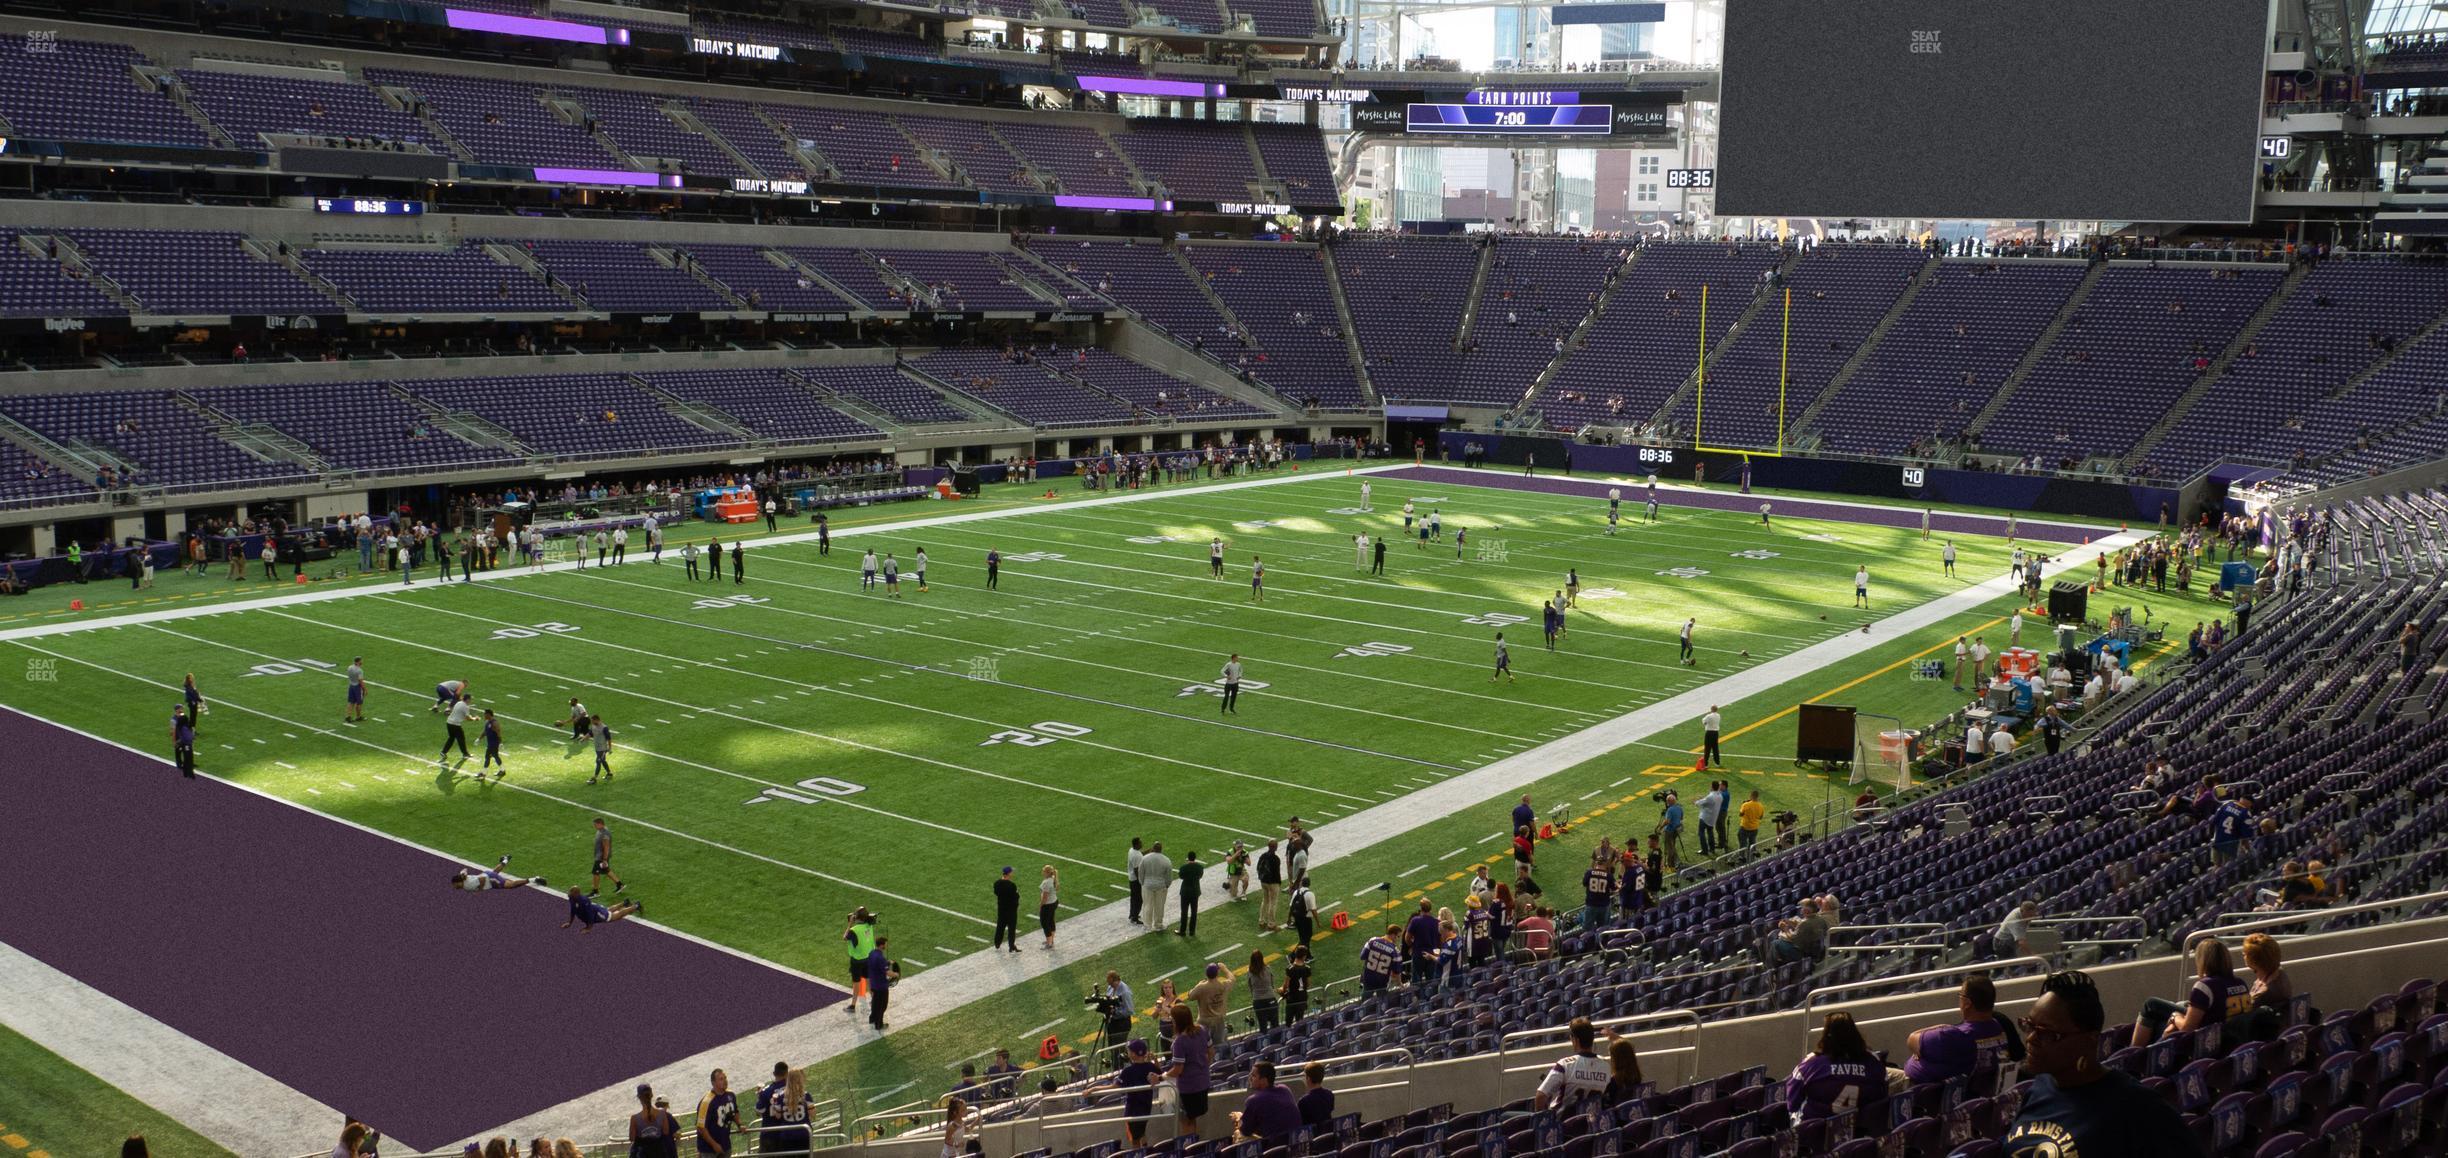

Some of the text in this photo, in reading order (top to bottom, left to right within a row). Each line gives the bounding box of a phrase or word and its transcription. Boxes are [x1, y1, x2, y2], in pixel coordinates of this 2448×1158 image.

[693, 38, 780, 60] TODAY'S MATCHUP
[1286, 88, 1370, 102] TODAY'S MATCHUP
[1479, 91, 1552, 105] EARN POINTS
[1494, 111, 1526, 126] 7:00
[2263, 139, 2288, 157] 40
[735, 178, 807, 194] TODAY'S MATCHUP
[1669, 170, 1711, 187] 88:36
[354, 200, 386, 212] 88:36
[1221, 202, 1291, 215] TODAY'S MATCHUP
[1639, 448, 1673, 463] 88:36
[1905, 470, 1922, 484] 40
[1461, 612, 1530, 628] 50
[1344, 641, 1415, 657] 40
[250, 658, 337, 676] 10
[989, 720, 1094, 747] 20
[761, 776, 868, 804] 10
[2222, 816, 2234, 834] 4
[1588, 877, 1608, 894] 80
[1366, 949, 1393, 975] 52
[1046, 1038, 1060, 1056] G
[1575, 1069, 1608, 1083] GILLITZER
[1830, 1063, 1867, 1077] FAVRE
[1831, 1084, 1860, 1115] 4
[2027, 1121, 2064, 1141] RAMS
